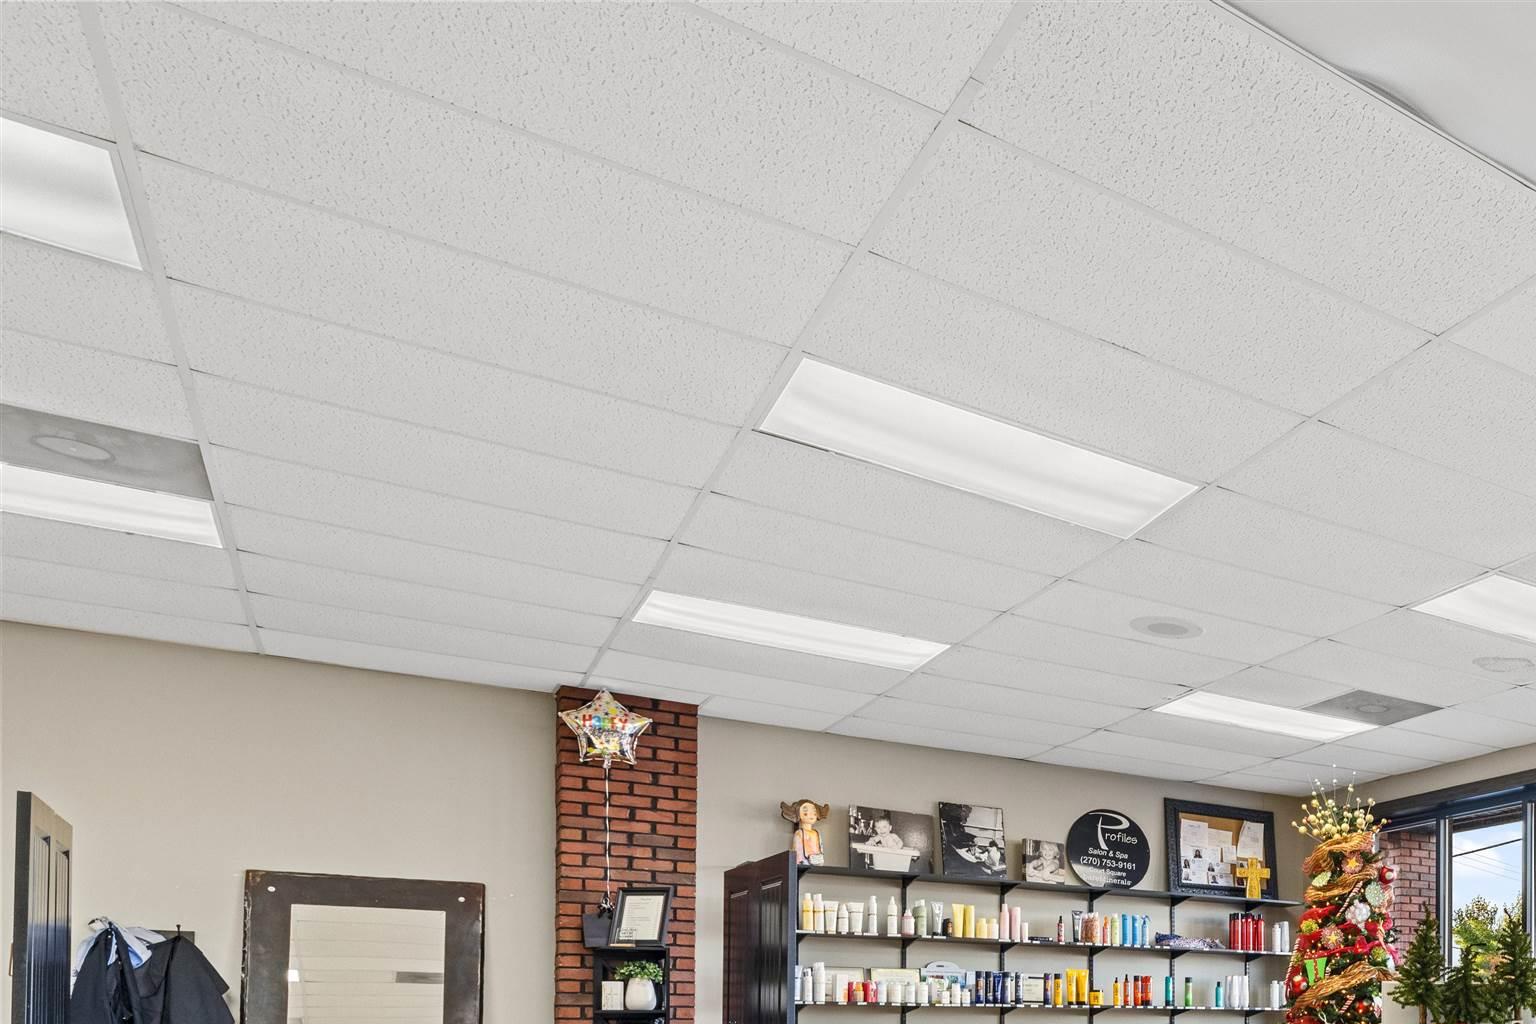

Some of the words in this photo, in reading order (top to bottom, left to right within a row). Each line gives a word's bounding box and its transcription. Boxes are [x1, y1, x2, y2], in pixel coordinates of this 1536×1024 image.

[1088, 811, 1138, 850] Profiles
[1088, 847, 1108, 856] Salon
[1115, 851, 1128, 859] Spa
[1080, 856, 1100, 867] (270)
[1102, 859, 1136, 870] 753-9161
[1106, 868, 1126, 877] Square
